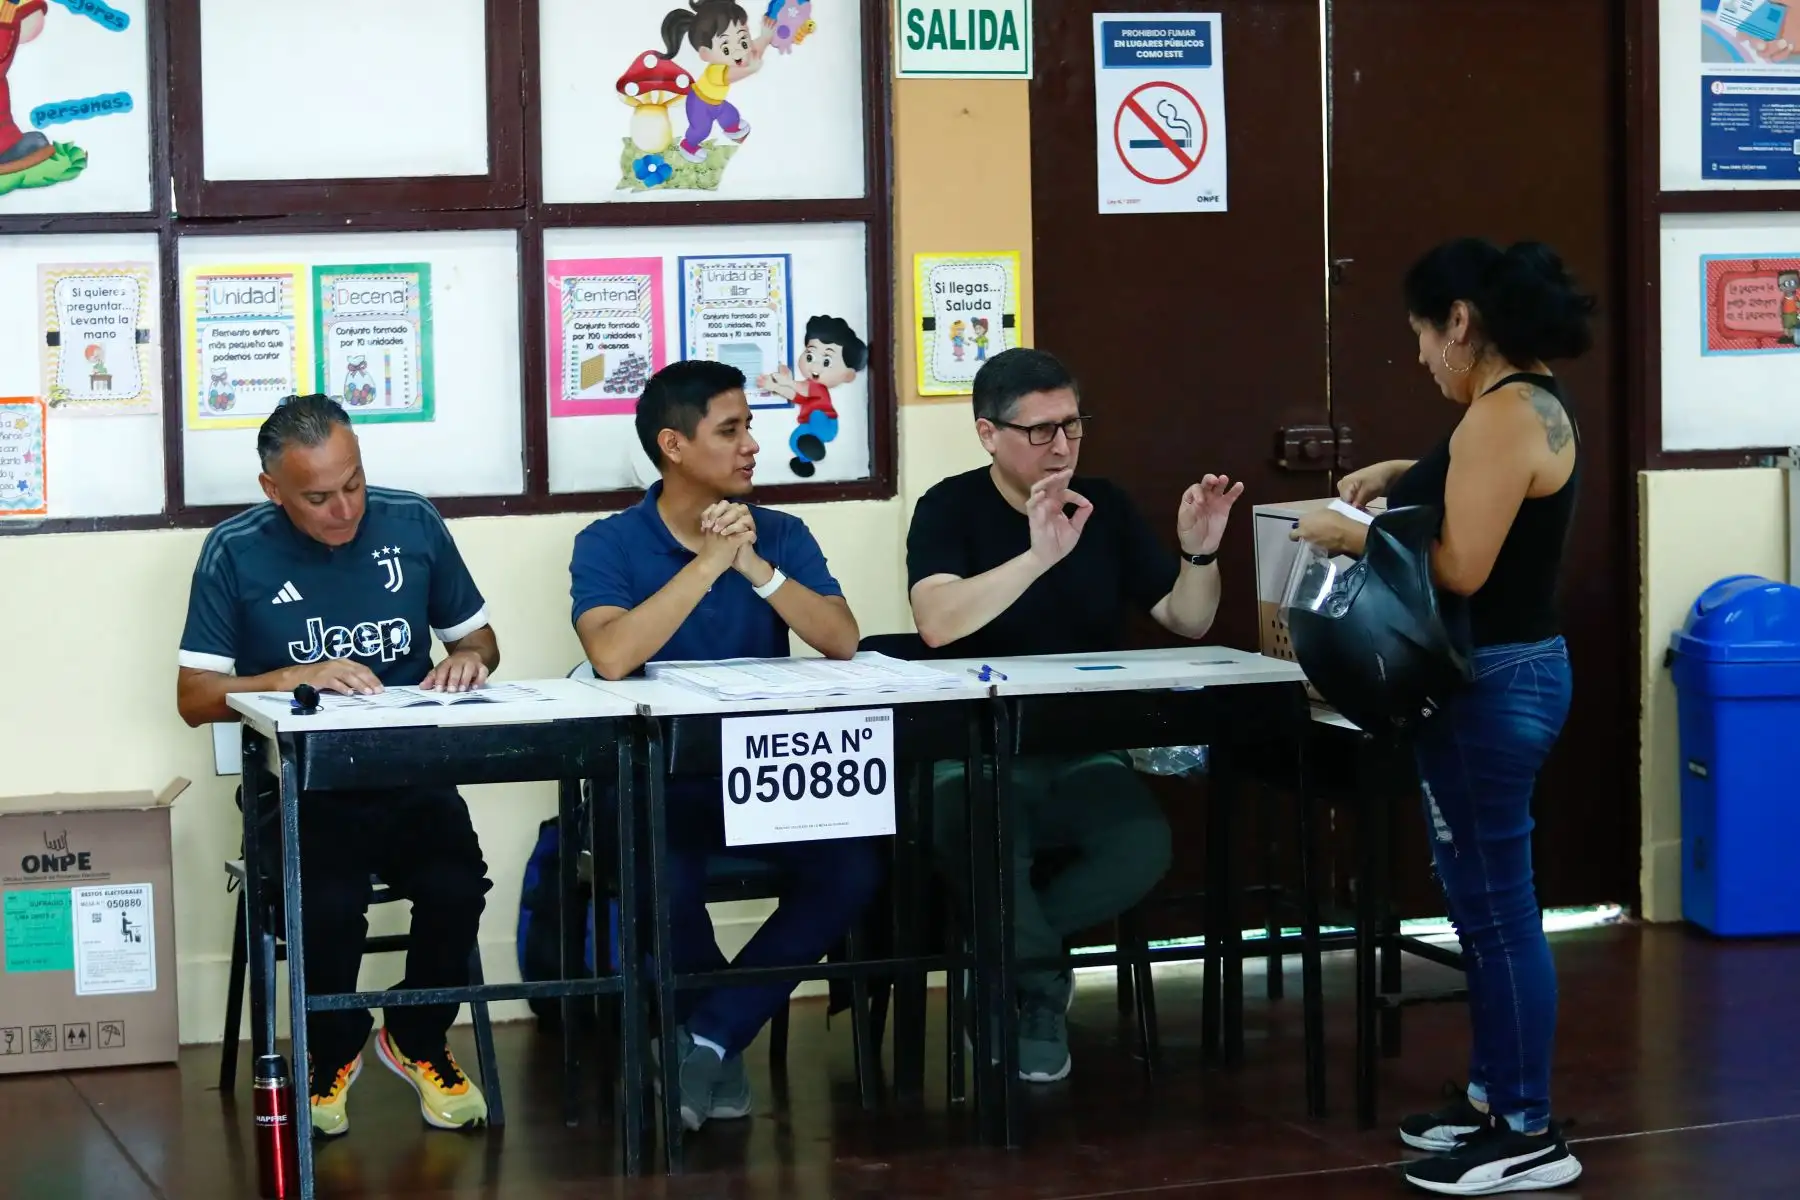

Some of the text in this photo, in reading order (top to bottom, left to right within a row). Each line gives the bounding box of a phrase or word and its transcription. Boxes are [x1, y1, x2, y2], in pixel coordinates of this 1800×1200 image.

[907, 8, 1020, 50] SALIDA
[1121, 29, 1196, 37] PROHIBIDO FUMAR
[1114, 38, 1204, 48] EN LUGARES PÚBLICOS
[1136, 50, 1163, 58] COMO
[707, 270, 763, 282] Unidad de
[72, 287, 81, 297] Si
[935, 282, 1001, 296] Si llegas...
[213, 286, 276, 305] Unidad
[338, 288, 404, 305] Decena
[574, 288, 637, 302] Centena
[945, 299, 992, 311] Saluda
[70, 315, 129, 326] Levanta la
[759, 312, 770, 320] por
[336, 325, 408, 336] Conjunto formado
[574, 321, 640, 331] Conjunto formado
[84, 331, 116, 339] mano
[211, 328, 280, 337] Elemento entero
[572, 333, 585, 341] por
[268, 341, 284, 349] que
[340, 337, 404, 348] por 10 unidades
[212, 352, 280, 362] podemos contar
[288, 617, 412, 664] Jeep
[746, 731, 833, 760] MESA
[727, 757, 887, 805] 050880
[22, 852, 92, 873] ONPE
[106, 898, 142, 908] 050880
